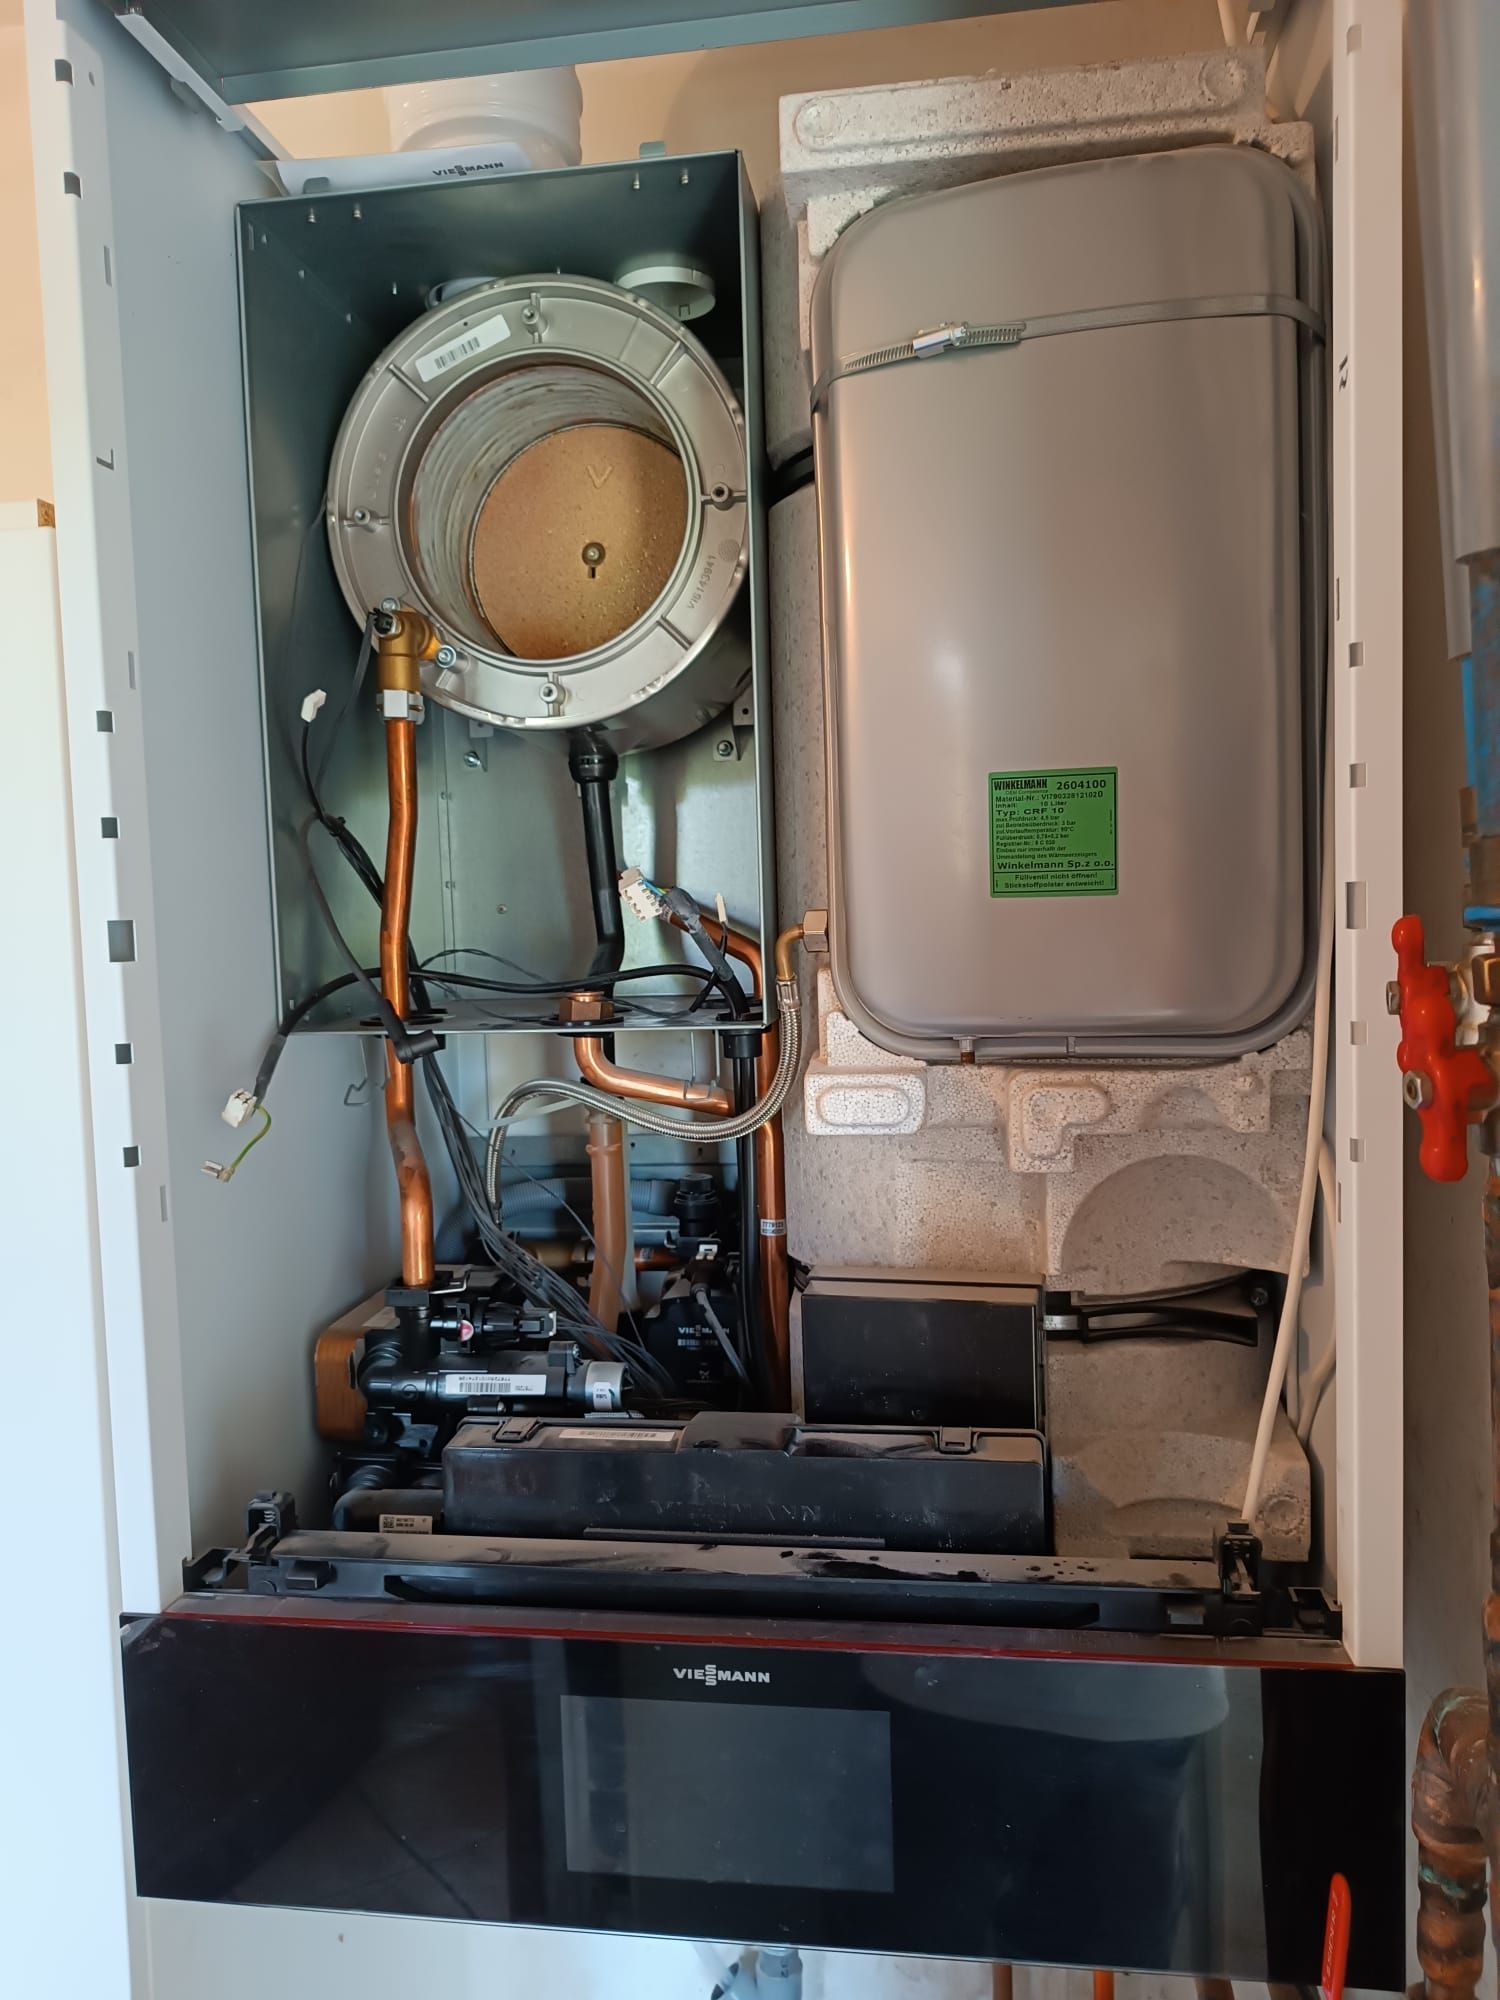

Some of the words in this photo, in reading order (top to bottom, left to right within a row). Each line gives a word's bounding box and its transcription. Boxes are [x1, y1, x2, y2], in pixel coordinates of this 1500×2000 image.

[433, 162, 504, 176] VIESSMANN
[994, 779, 1047, 791] WINKELMANN
[1056, 779, 1106, 790] 2604100
[998, 860, 1064, 870] Winkelmann
[673, 1664, 770, 1686] VIESSMANN
